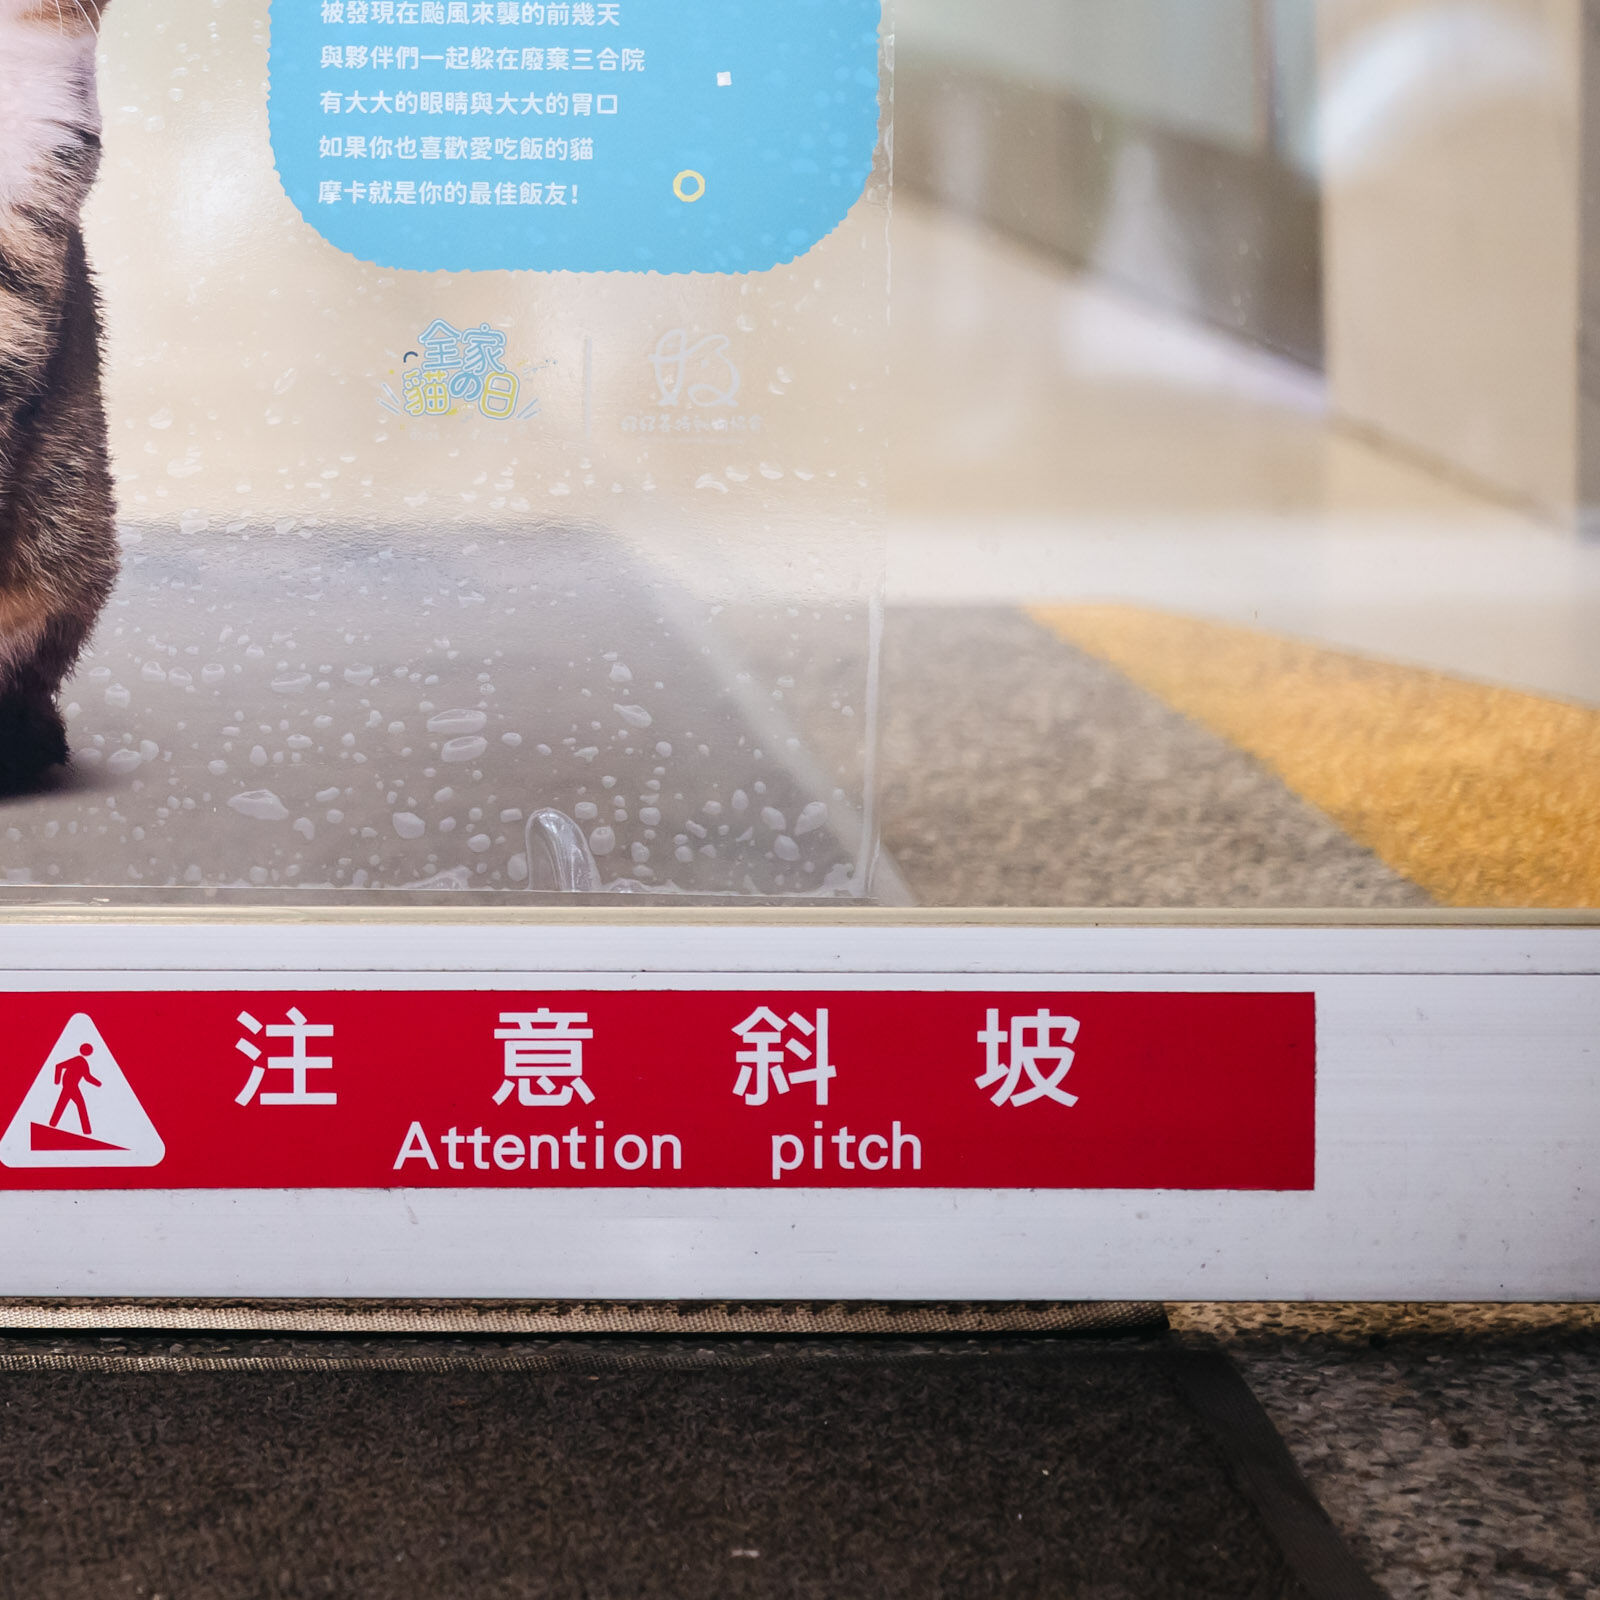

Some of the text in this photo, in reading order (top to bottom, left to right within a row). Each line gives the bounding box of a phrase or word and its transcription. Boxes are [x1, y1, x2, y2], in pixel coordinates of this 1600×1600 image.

[320, 0, 622, 28] 被發現在颱風來襲的前幾天
[319, 45, 647, 73] 與夥伴們一起躲在廢棄三合院
[319, 90, 620, 117] 有大大的眼睛與大大的胃口
[318, 135, 595, 162] 如果你也喜歡愛吃飯的貓
[418, 318, 507, 375] 全家
[402, 369, 521, 421] 貓の日
[393, 1118, 923, 1180] Attention pitch
